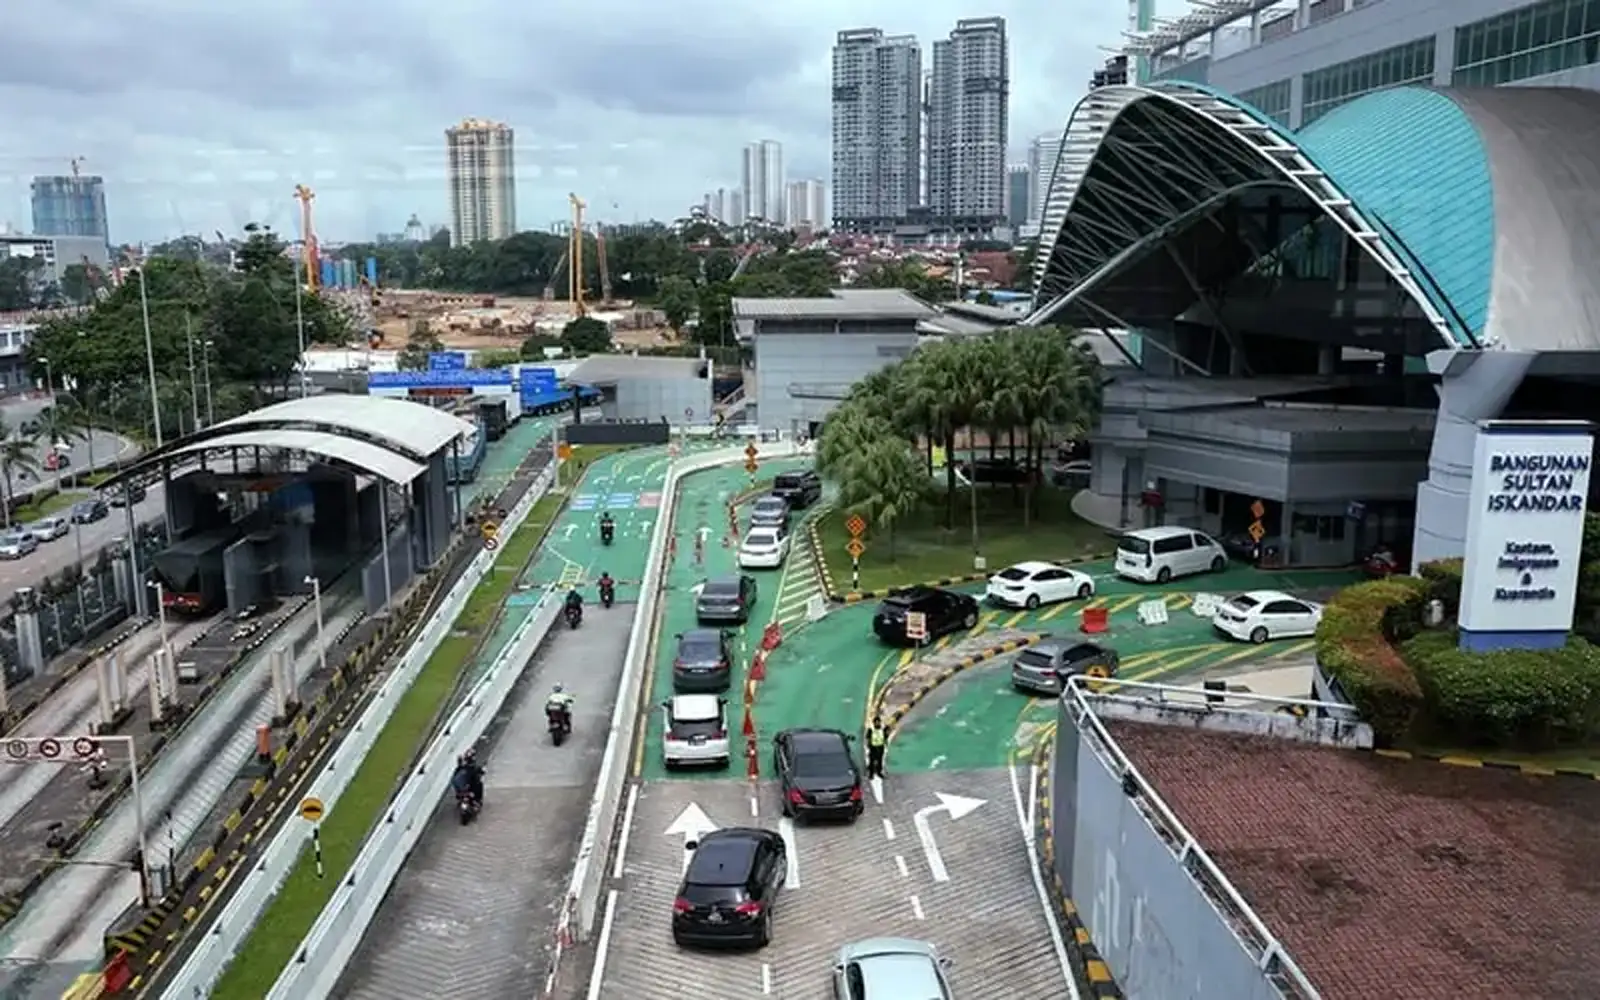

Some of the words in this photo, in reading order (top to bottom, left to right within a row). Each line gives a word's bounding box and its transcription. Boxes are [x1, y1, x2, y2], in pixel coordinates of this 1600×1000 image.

[1491, 455, 1589, 471] BANGUNAN
[1503, 474, 1573, 491] SULTAN
[1487, 495, 1583, 511] ISKANDAR
